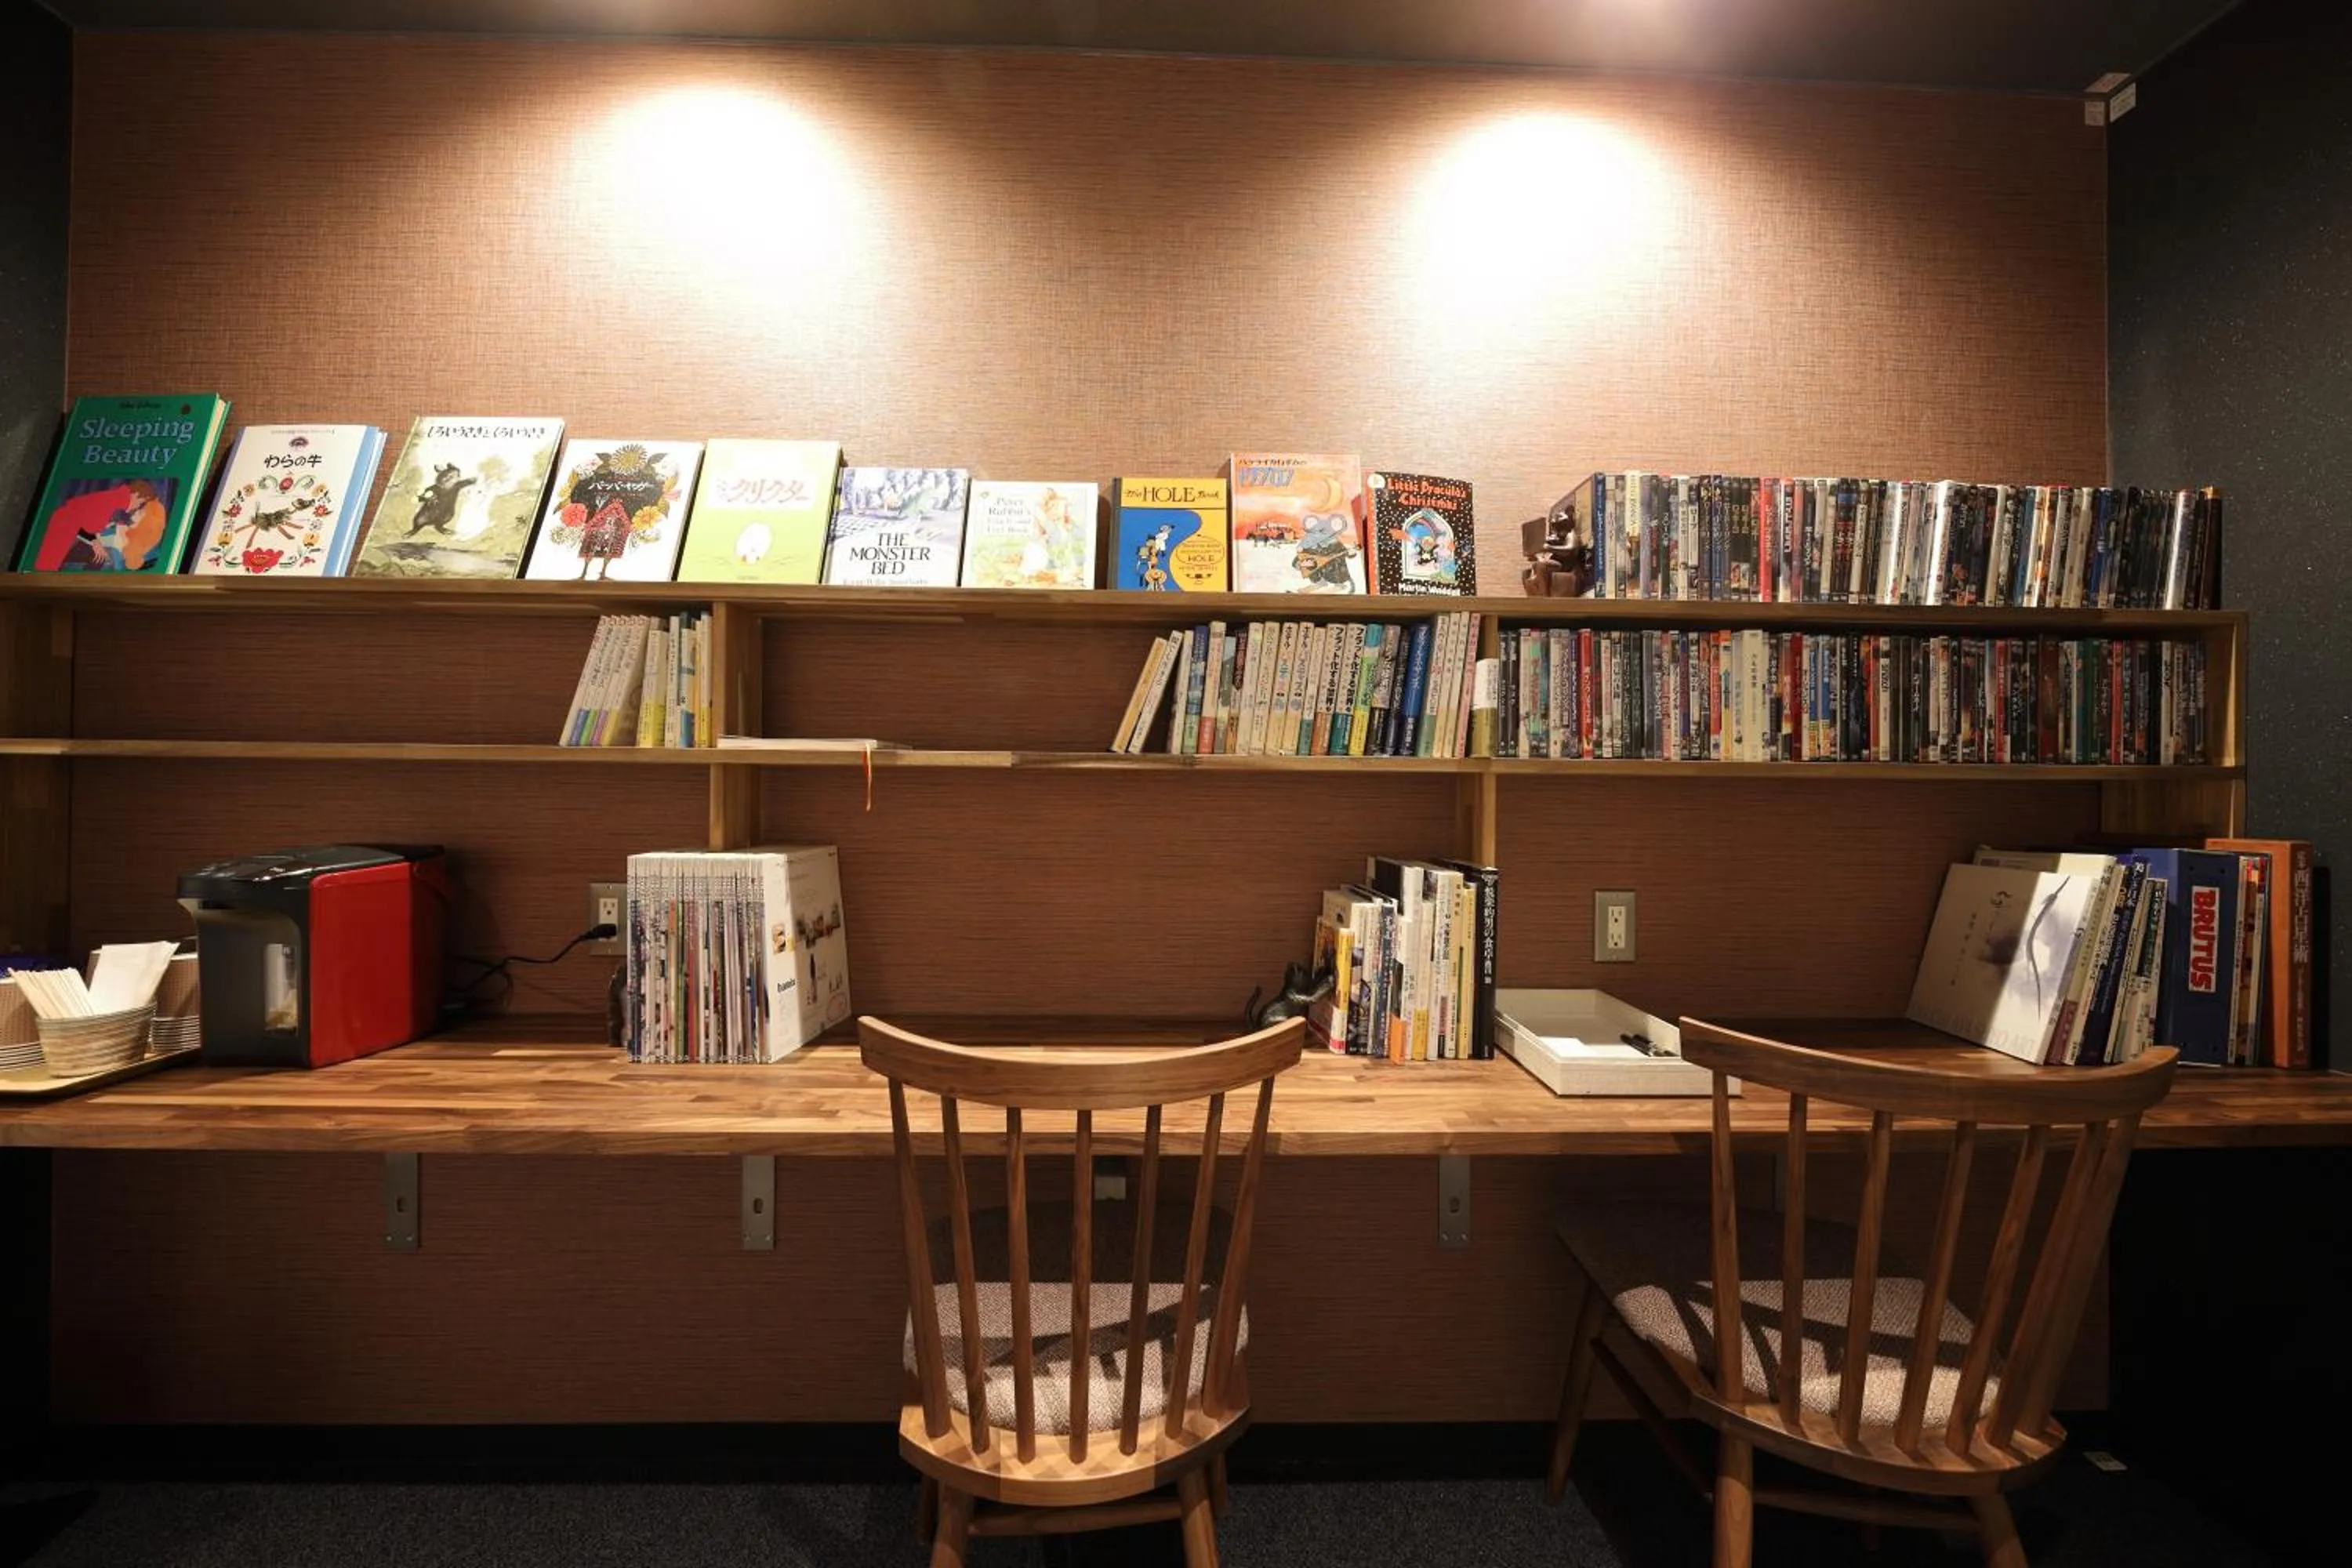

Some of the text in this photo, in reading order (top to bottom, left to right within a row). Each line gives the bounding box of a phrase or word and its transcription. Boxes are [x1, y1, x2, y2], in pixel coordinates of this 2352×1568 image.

[79, 416, 195, 445] Sleeping
[83, 445, 178, 470] Beauty
[264, 454, 322, 468] わらの牛
[727, 477, 811, 503] クリクター
[1142, 486, 1196, 503] HOLE
[1387, 477, 1467, 498] Little Dracula's
[1399, 492, 1457, 510] Christmas
[878, 532, 909, 546] THE
[849, 546, 931, 561] MONSTER
[871, 561, 906, 575] BED
[2191, 891, 2216, 989] BRUTUS
